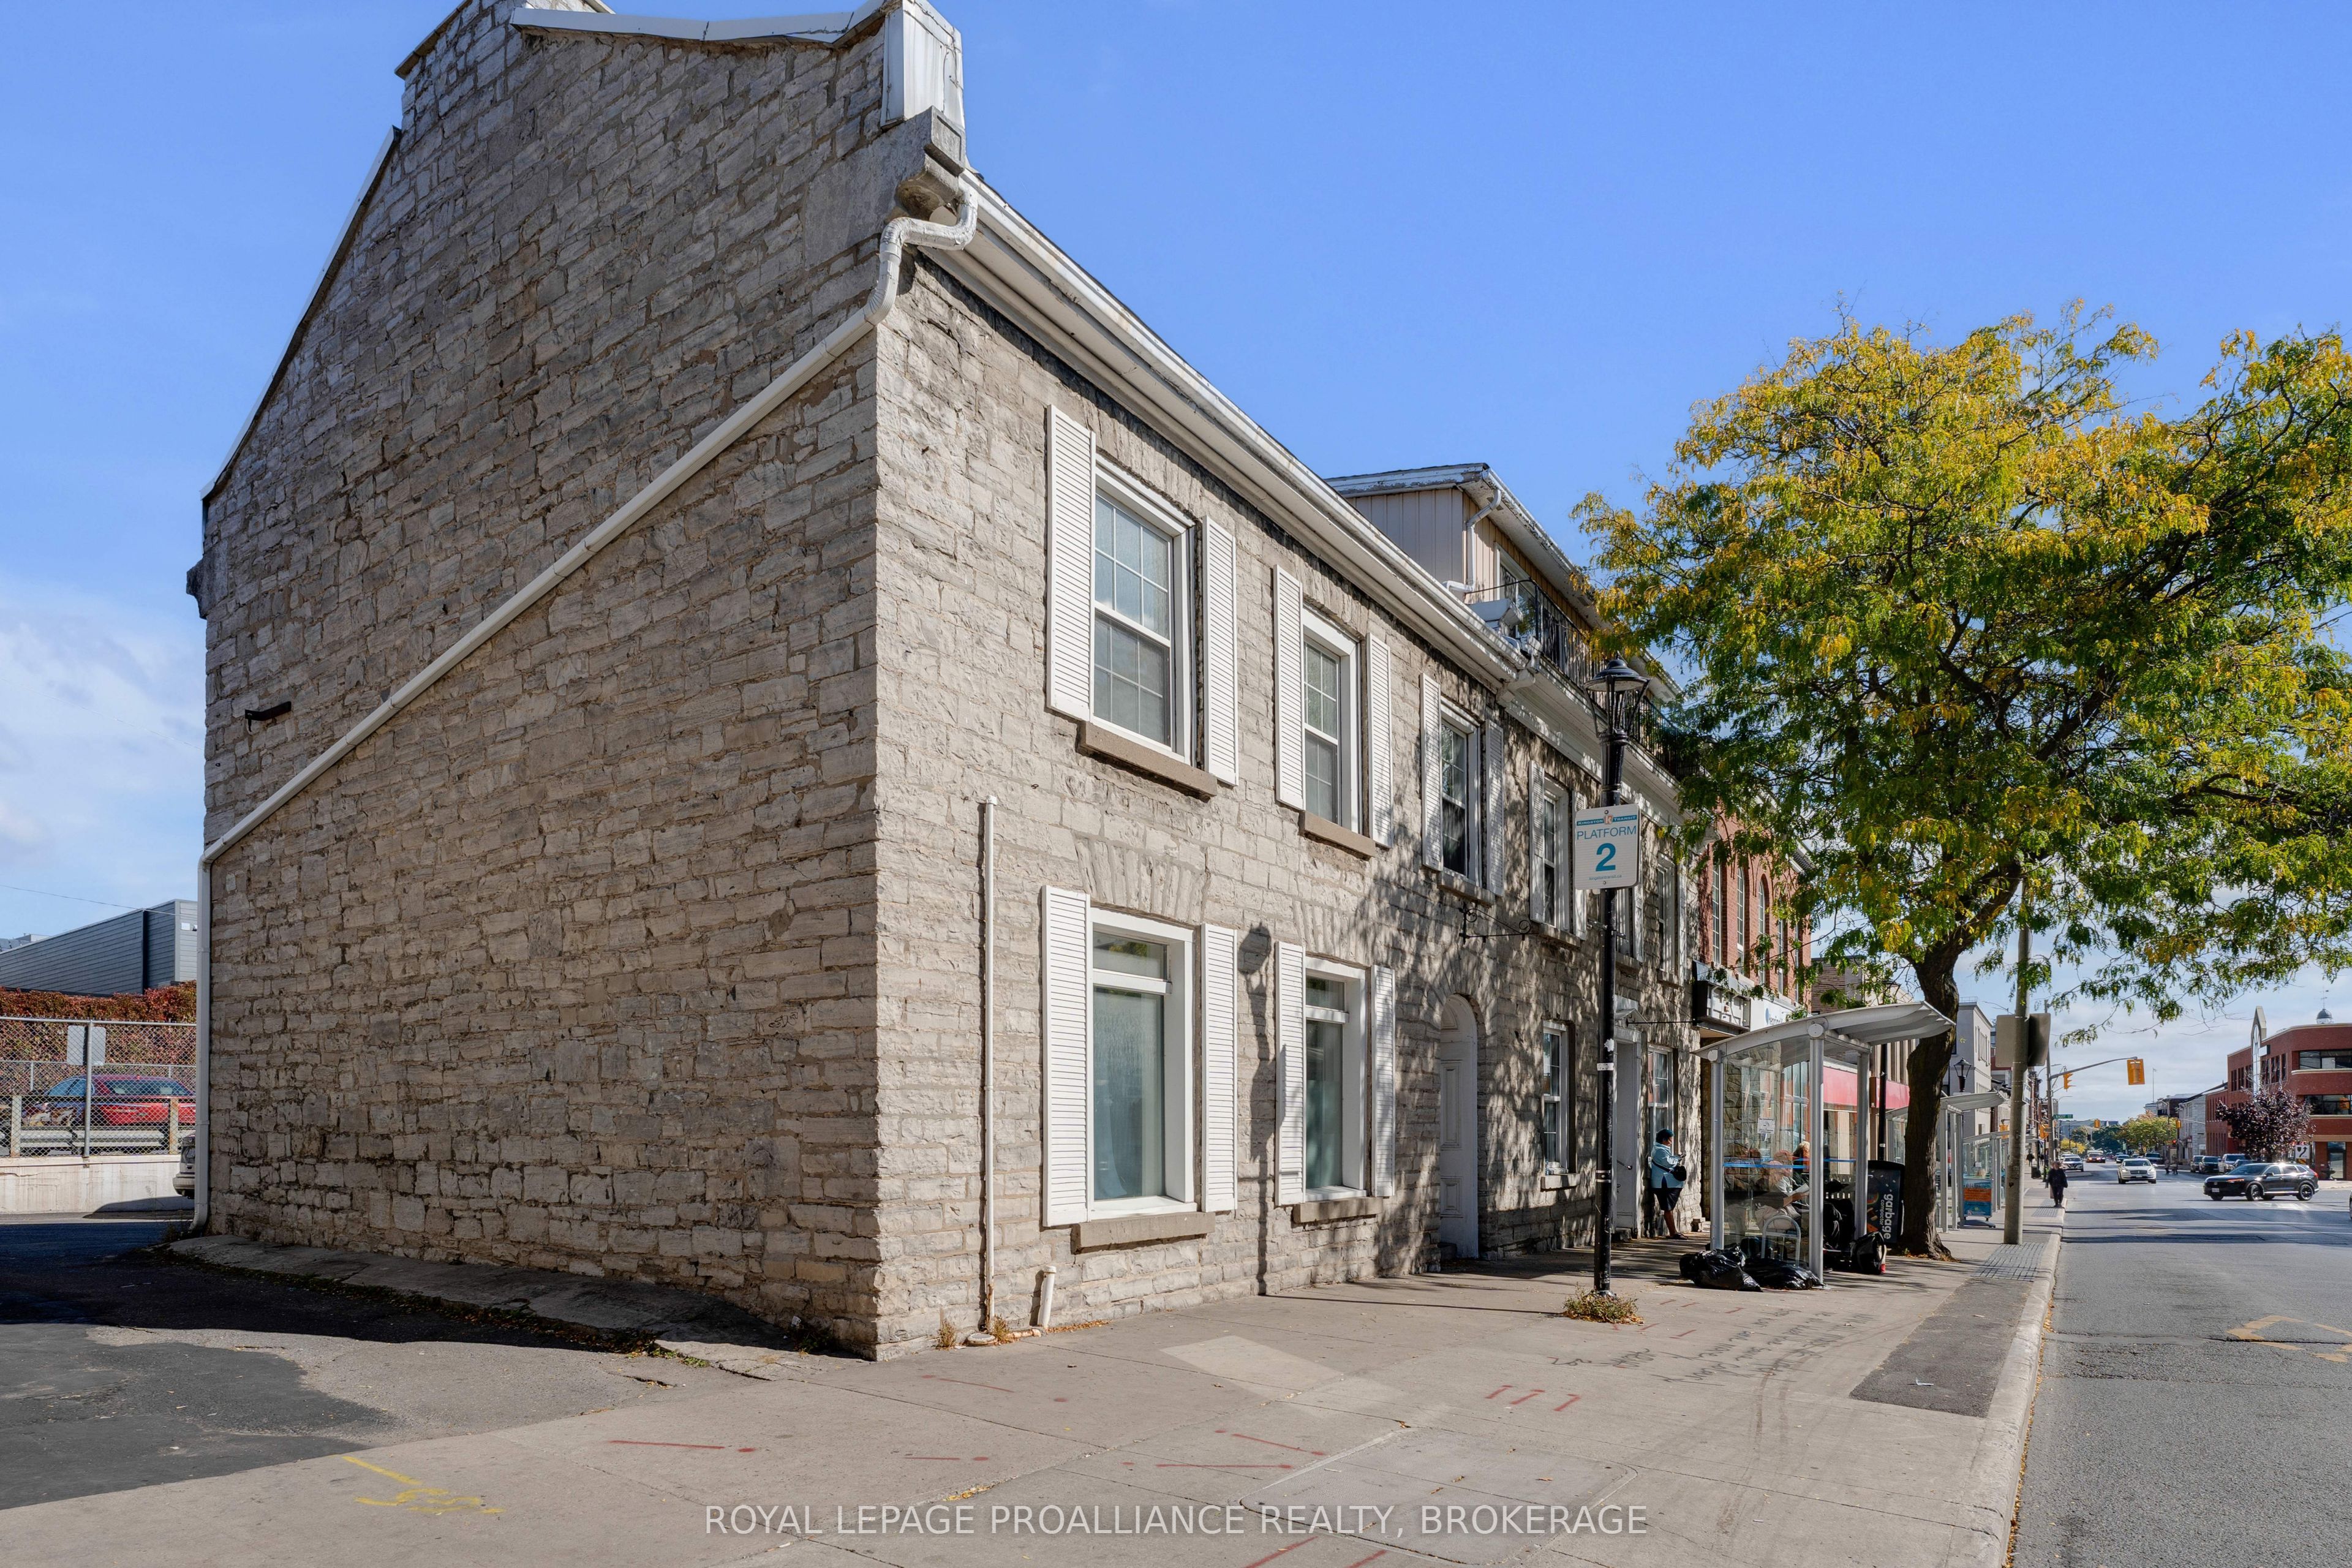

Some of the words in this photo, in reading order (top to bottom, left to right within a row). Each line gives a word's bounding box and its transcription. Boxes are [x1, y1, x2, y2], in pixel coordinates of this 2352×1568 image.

[1577, 826, 1637, 840] PLATFORM
[1596, 843, 1616, 872] 2
[1882, 1194, 1895, 1239] garbage
